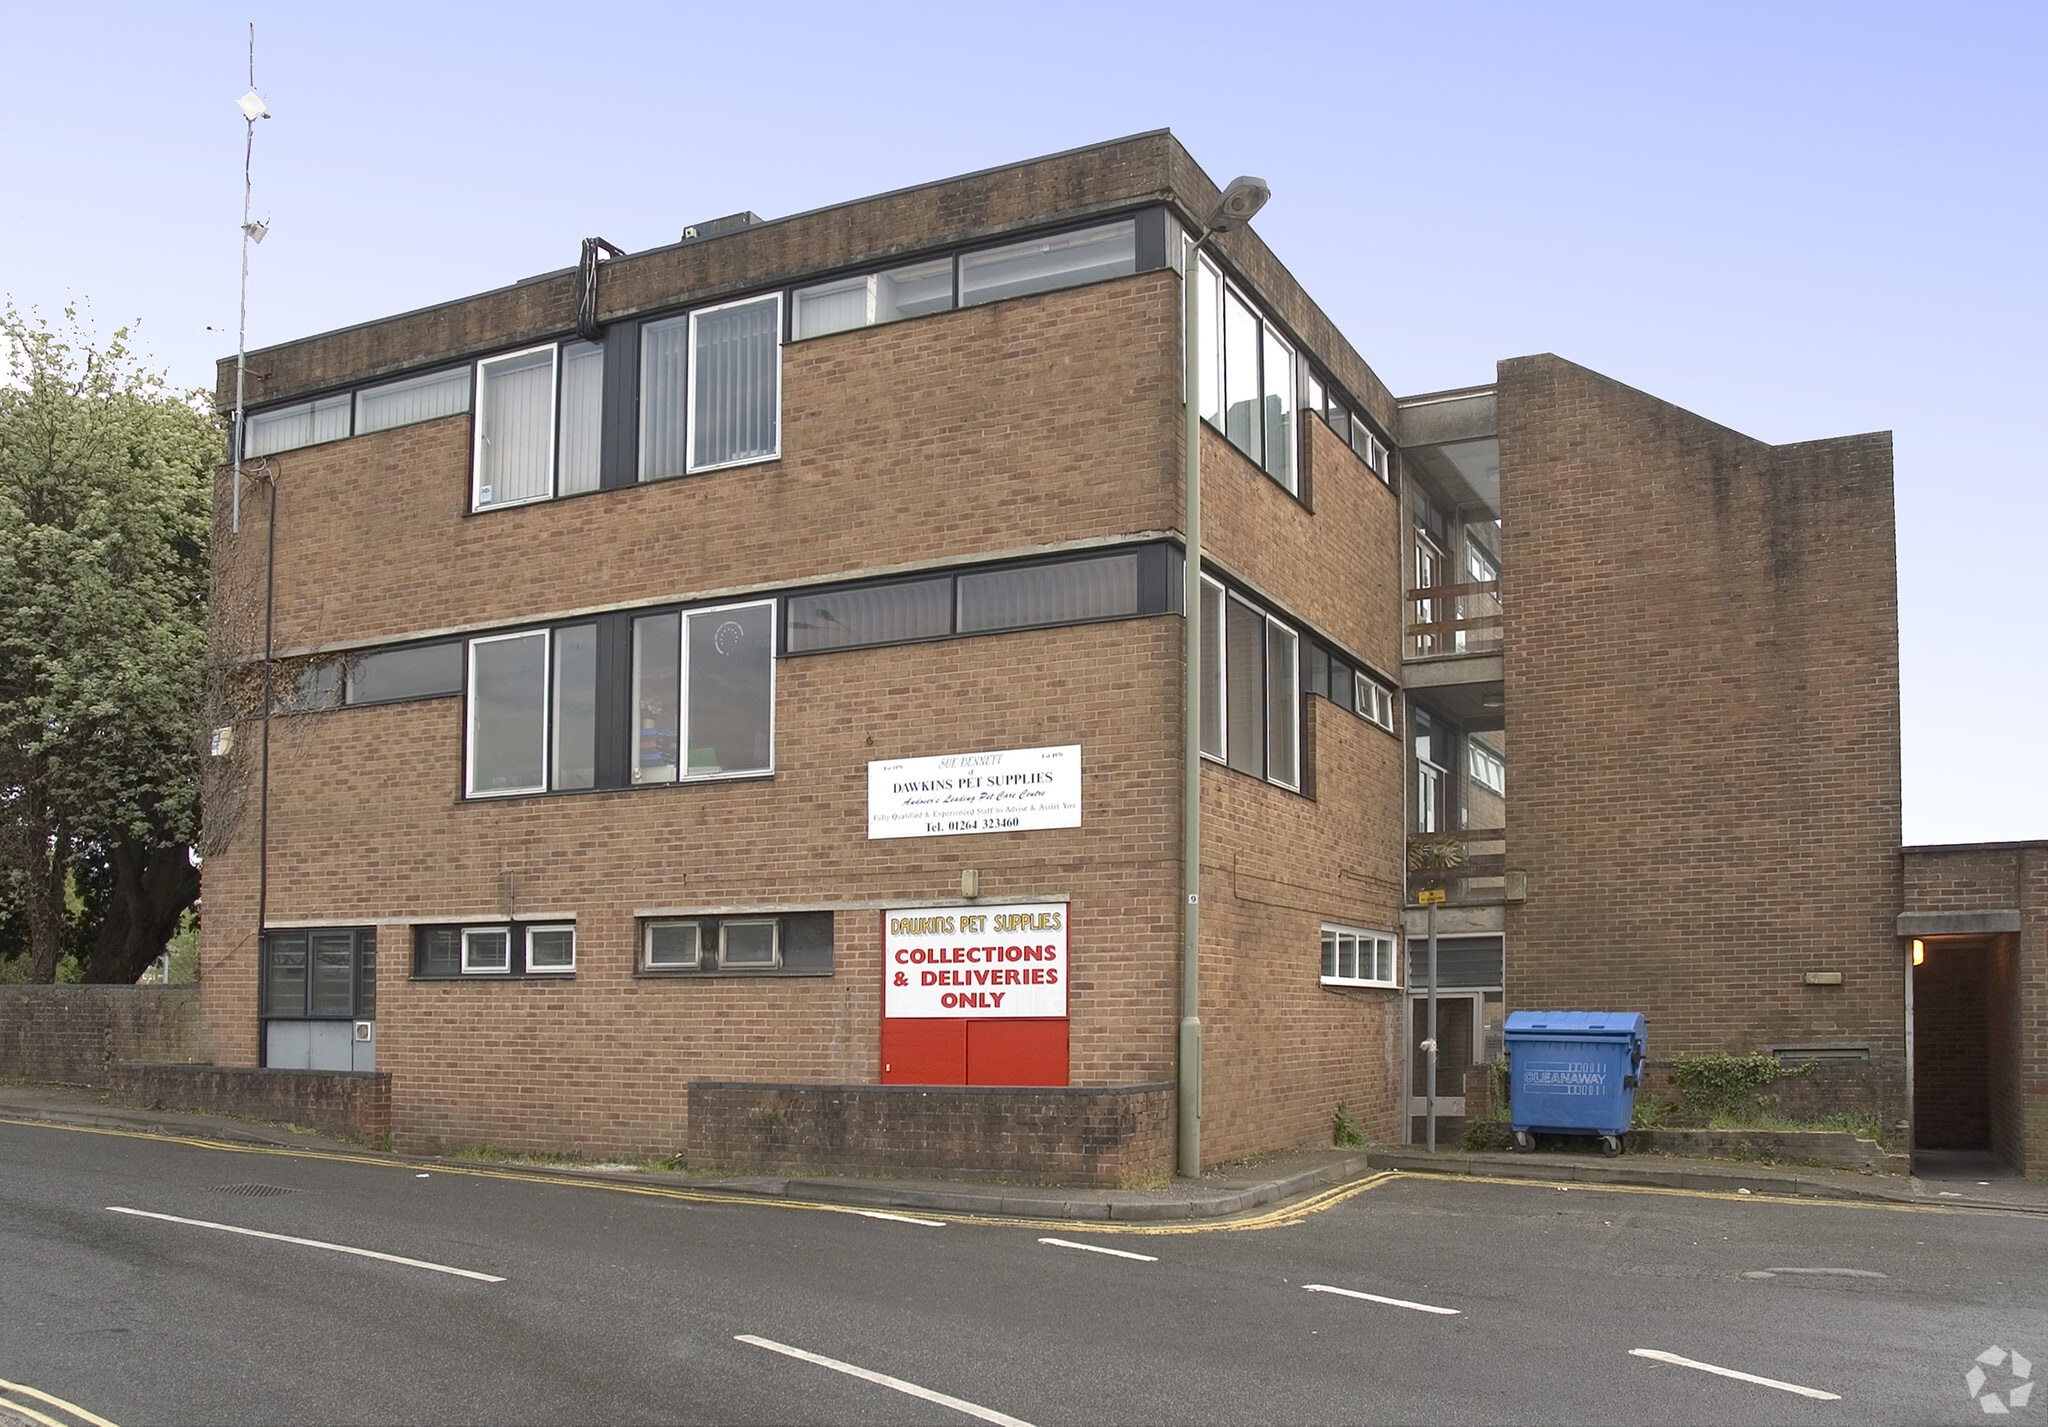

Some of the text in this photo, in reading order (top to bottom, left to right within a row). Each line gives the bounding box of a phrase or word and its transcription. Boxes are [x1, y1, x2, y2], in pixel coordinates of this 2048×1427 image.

[893, 771, 1053, 794] DAWKINS PET SUPPLIES
[943, 793, 976, 804] Leading
[979, 791, 995, 801] Pet
[996, 790, 1016, 801] Care
[1018, 788, 1046, 800] Centre
[891, 811, 923, 821] Qualified
[933, 808, 975, 819] Experienced
[976, 806, 994, 815] Staff
[1005, 804, 1028, 813] Advise
[1062, 801, 1076, 809] You
[925, 817, 1019, 832] Tel. 01264 323460
[1190, 895, 1197, 903] 9
[891, 911, 1062, 936] DAWKINS PET SUPPLIES
[895, 944, 1057, 965] COLLECTIONS
[893, 968, 1058, 987] & DELIVERIES
[940, 992, 1006, 1009] ONLY
[1524, 1072, 1607, 1084] CLEANAWAY
